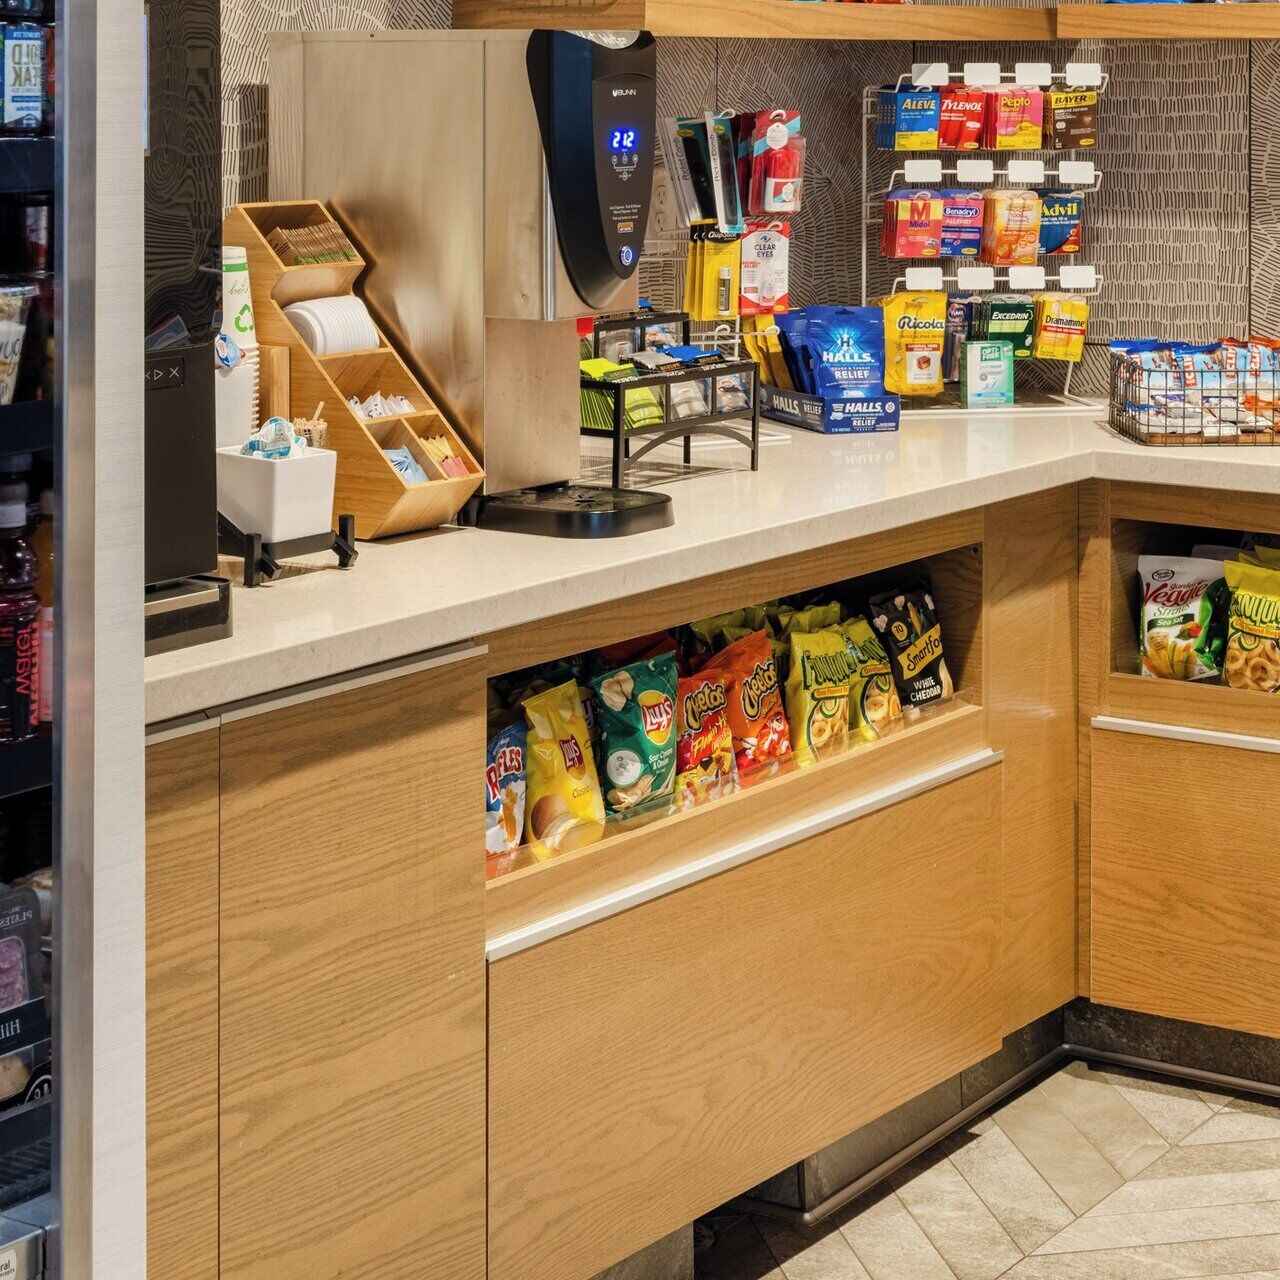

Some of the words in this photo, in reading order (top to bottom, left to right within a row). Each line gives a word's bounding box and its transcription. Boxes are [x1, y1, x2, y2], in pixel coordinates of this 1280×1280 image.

[902, 99, 936, 110] ALEVE
[942, 99, 983, 111] TYLENOL
[1001, 96, 1031, 107] Pepto
[1055, 95, 1087, 105] BAYER
[945, 208, 977, 217] Benadryl
[1040, 202, 1078, 216] Advil
[910, 220, 930, 228] Midol
[754, 243, 776, 251] CLEAR
[992, 311, 1030, 320] EXCEDRIN
[898, 316, 945, 331] Ricola
[1045, 315, 1086, 328] Dramamine
[835, 369, 869, 379] RELIEF
[852, 419, 876, 428] RELIEF
[913, 678, 937, 690] WHITE
